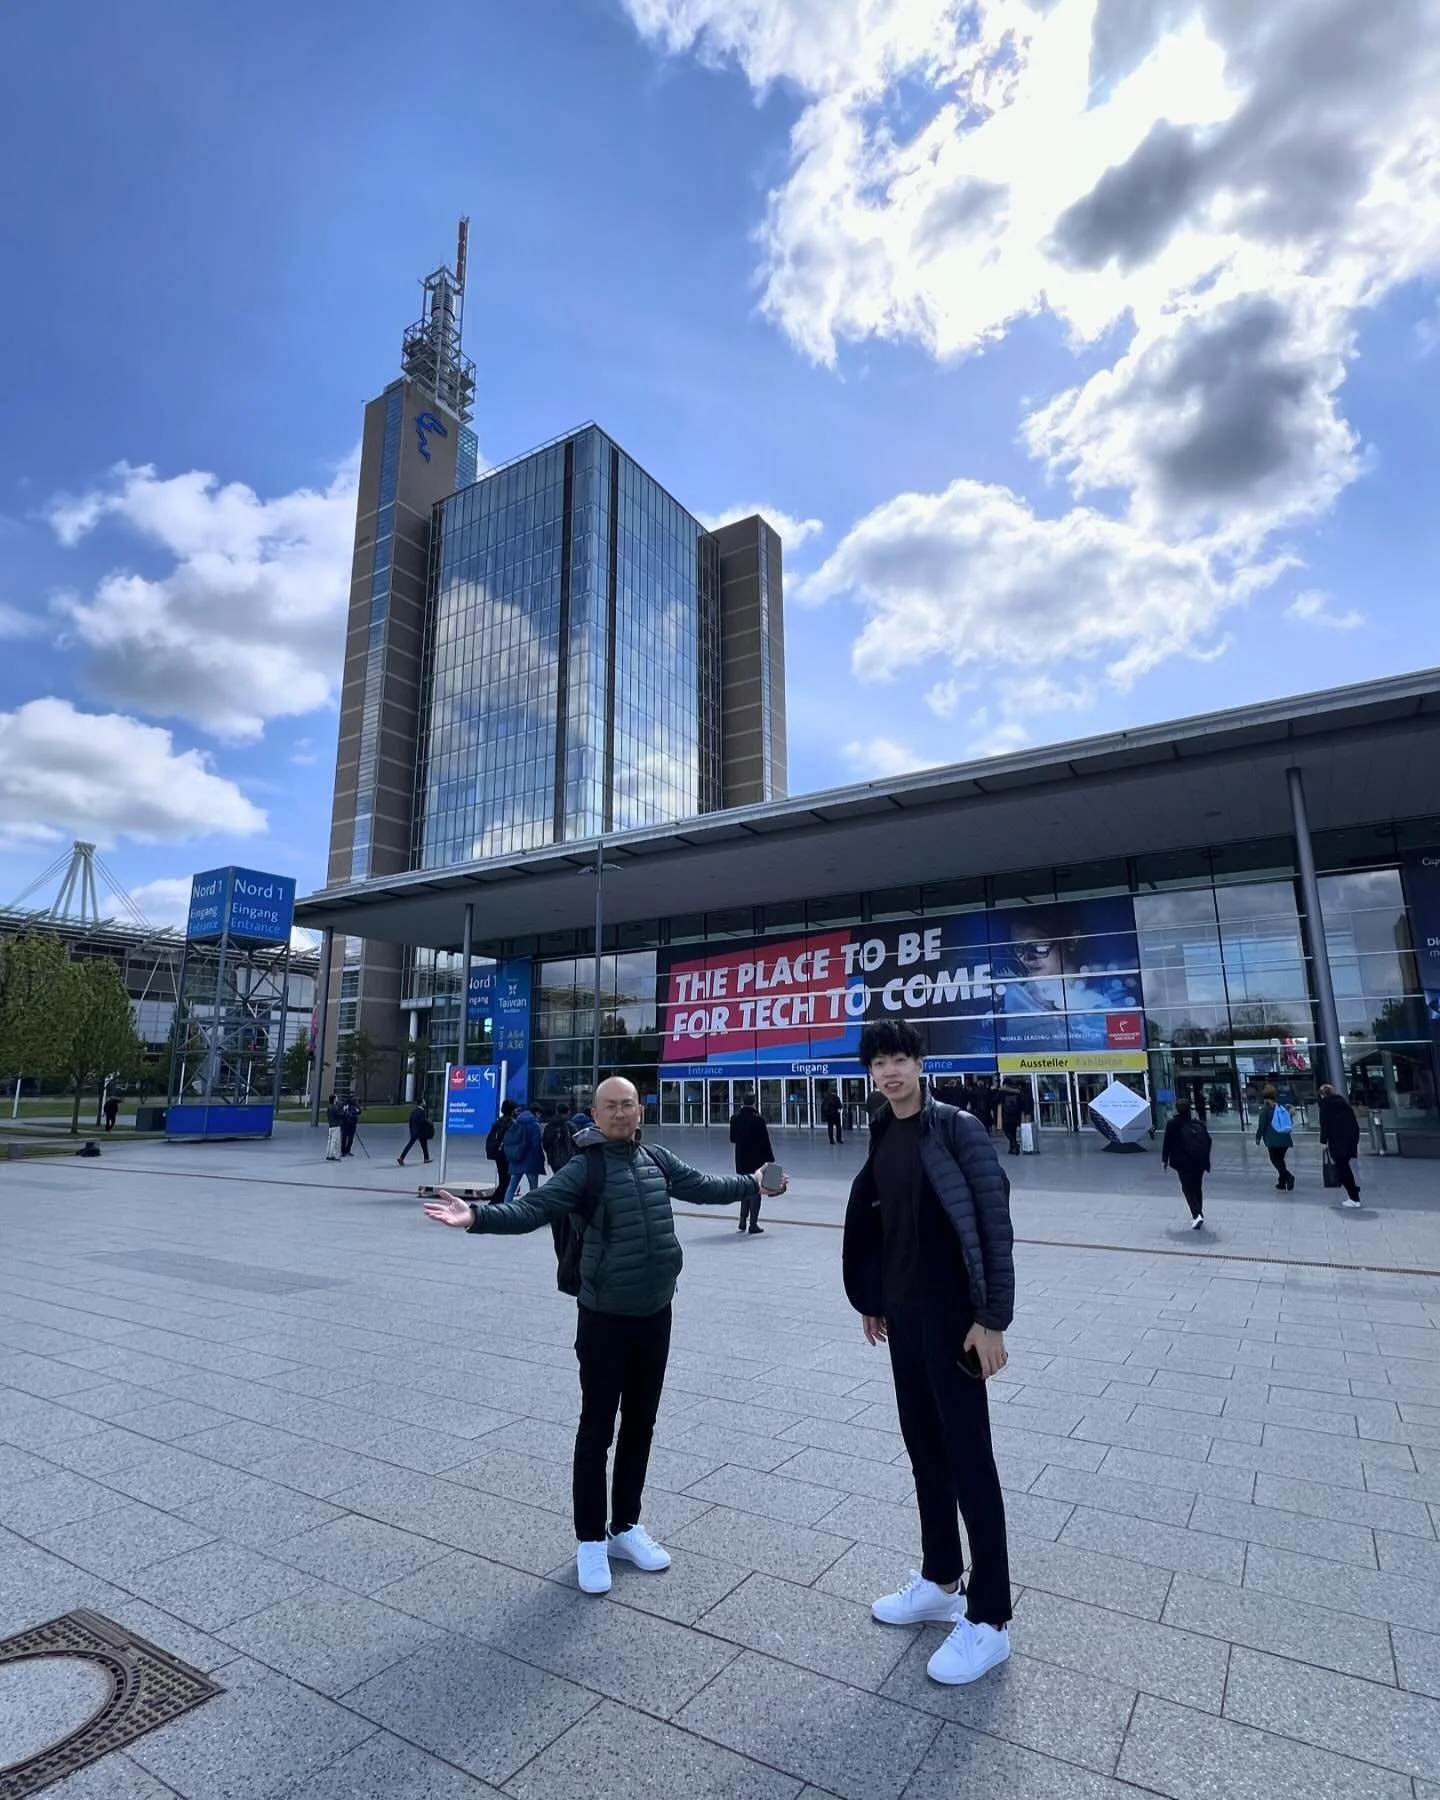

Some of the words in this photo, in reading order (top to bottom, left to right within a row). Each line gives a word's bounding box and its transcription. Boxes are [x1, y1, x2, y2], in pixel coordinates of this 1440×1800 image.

[192, 880, 217, 899] Nord
[217, 880, 222, 893] 1
[234, 878, 274, 899] Nord
[277, 887, 284, 901] 1
[190, 905, 219, 920] Eingang
[232, 902, 279, 923] Eingang
[231, 917, 281, 935] Entrance
[676, 966, 729, 1003] THE
[737, 948, 830, 994] PLACE
[840, 938, 886, 975] TO
[897, 927, 942, 966] BE
[499, 997, 527, 1008] Taiwan
[672, 1006, 730, 1042] FOR
[739, 994, 816, 1031] TECH
[825, 983, 872, 1020] TO
[882, 963, 1007, 1011] COME.
[688, 1066, 724, 1075] Entrance
[791, 1062, 829, 1074] Eingang
[924, 1061, 953, 1069] rance
[1020, 1058, 1069, 1069] Aussteller
[466, 1073, 480, 1083] ASC
